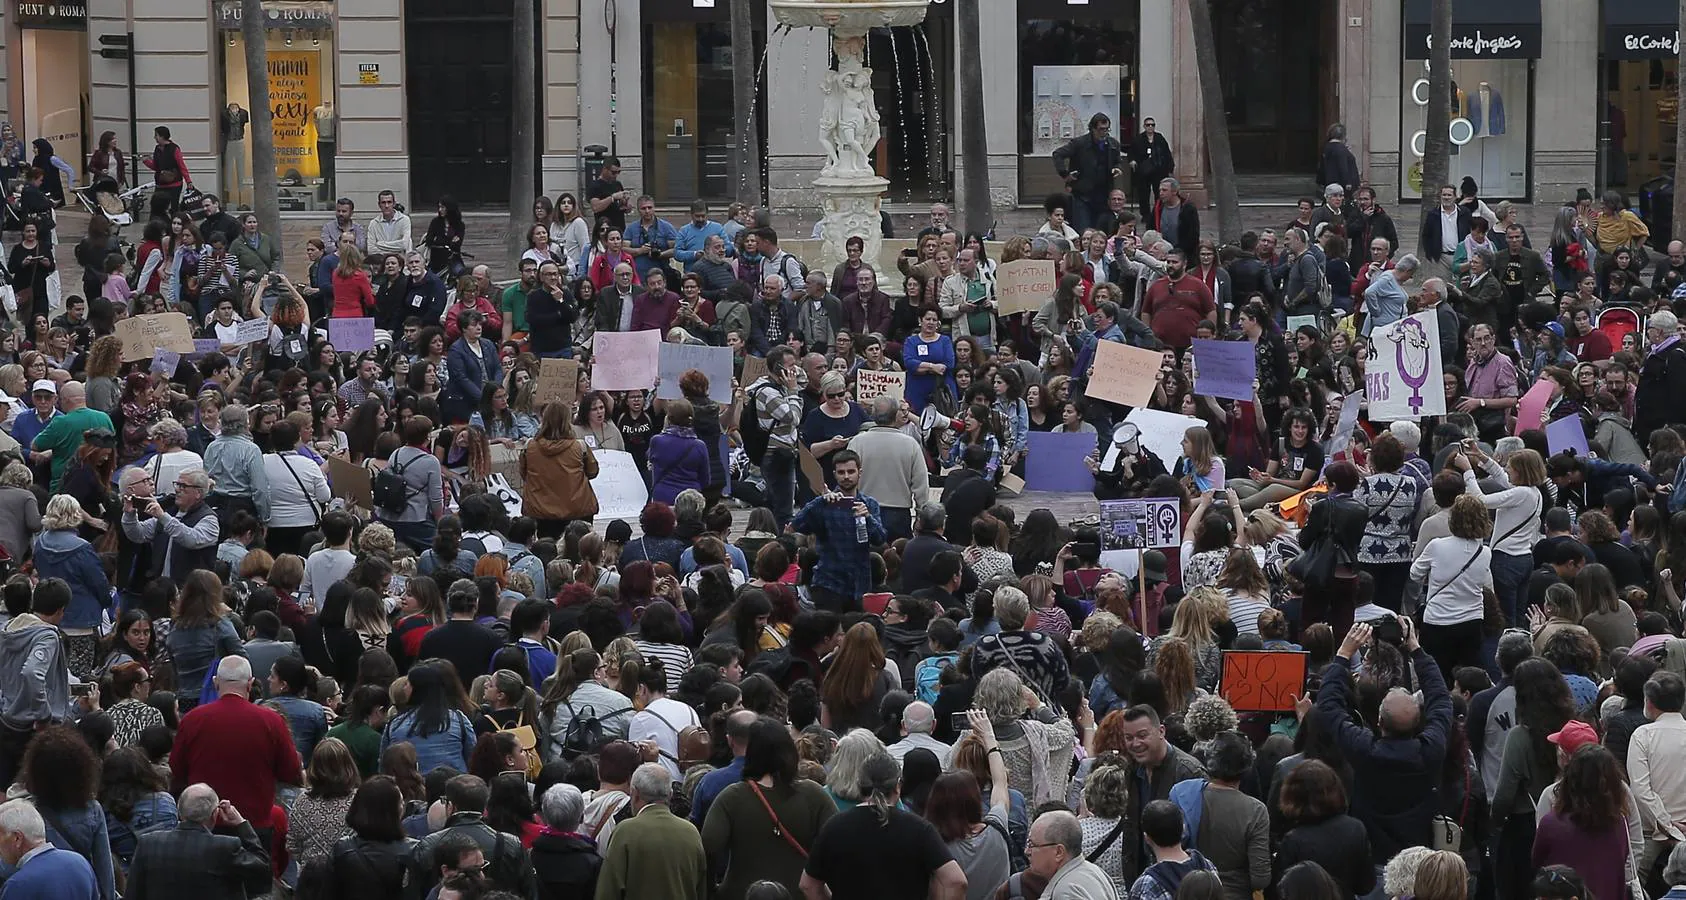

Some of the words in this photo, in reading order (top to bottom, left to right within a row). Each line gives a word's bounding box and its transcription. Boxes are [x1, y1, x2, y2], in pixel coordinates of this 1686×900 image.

[19, 4, 44, 16] PUNT
[59, 5, 86, 17] ROMA
[222, 8, 243, 20] PU
[283, 8, 328, 20] ROMA
[1449, 36, 1474, 49] orte
[1474, 30, 1521, 54] Inglés
[1624, 34, 1640, 50] El
[1639, 35, 1672, 50] Corte
[269, 88, 308, 101] ariñosa
[877, 384, 887, 392] TE
[1224, 654, 1277, 683] NO
